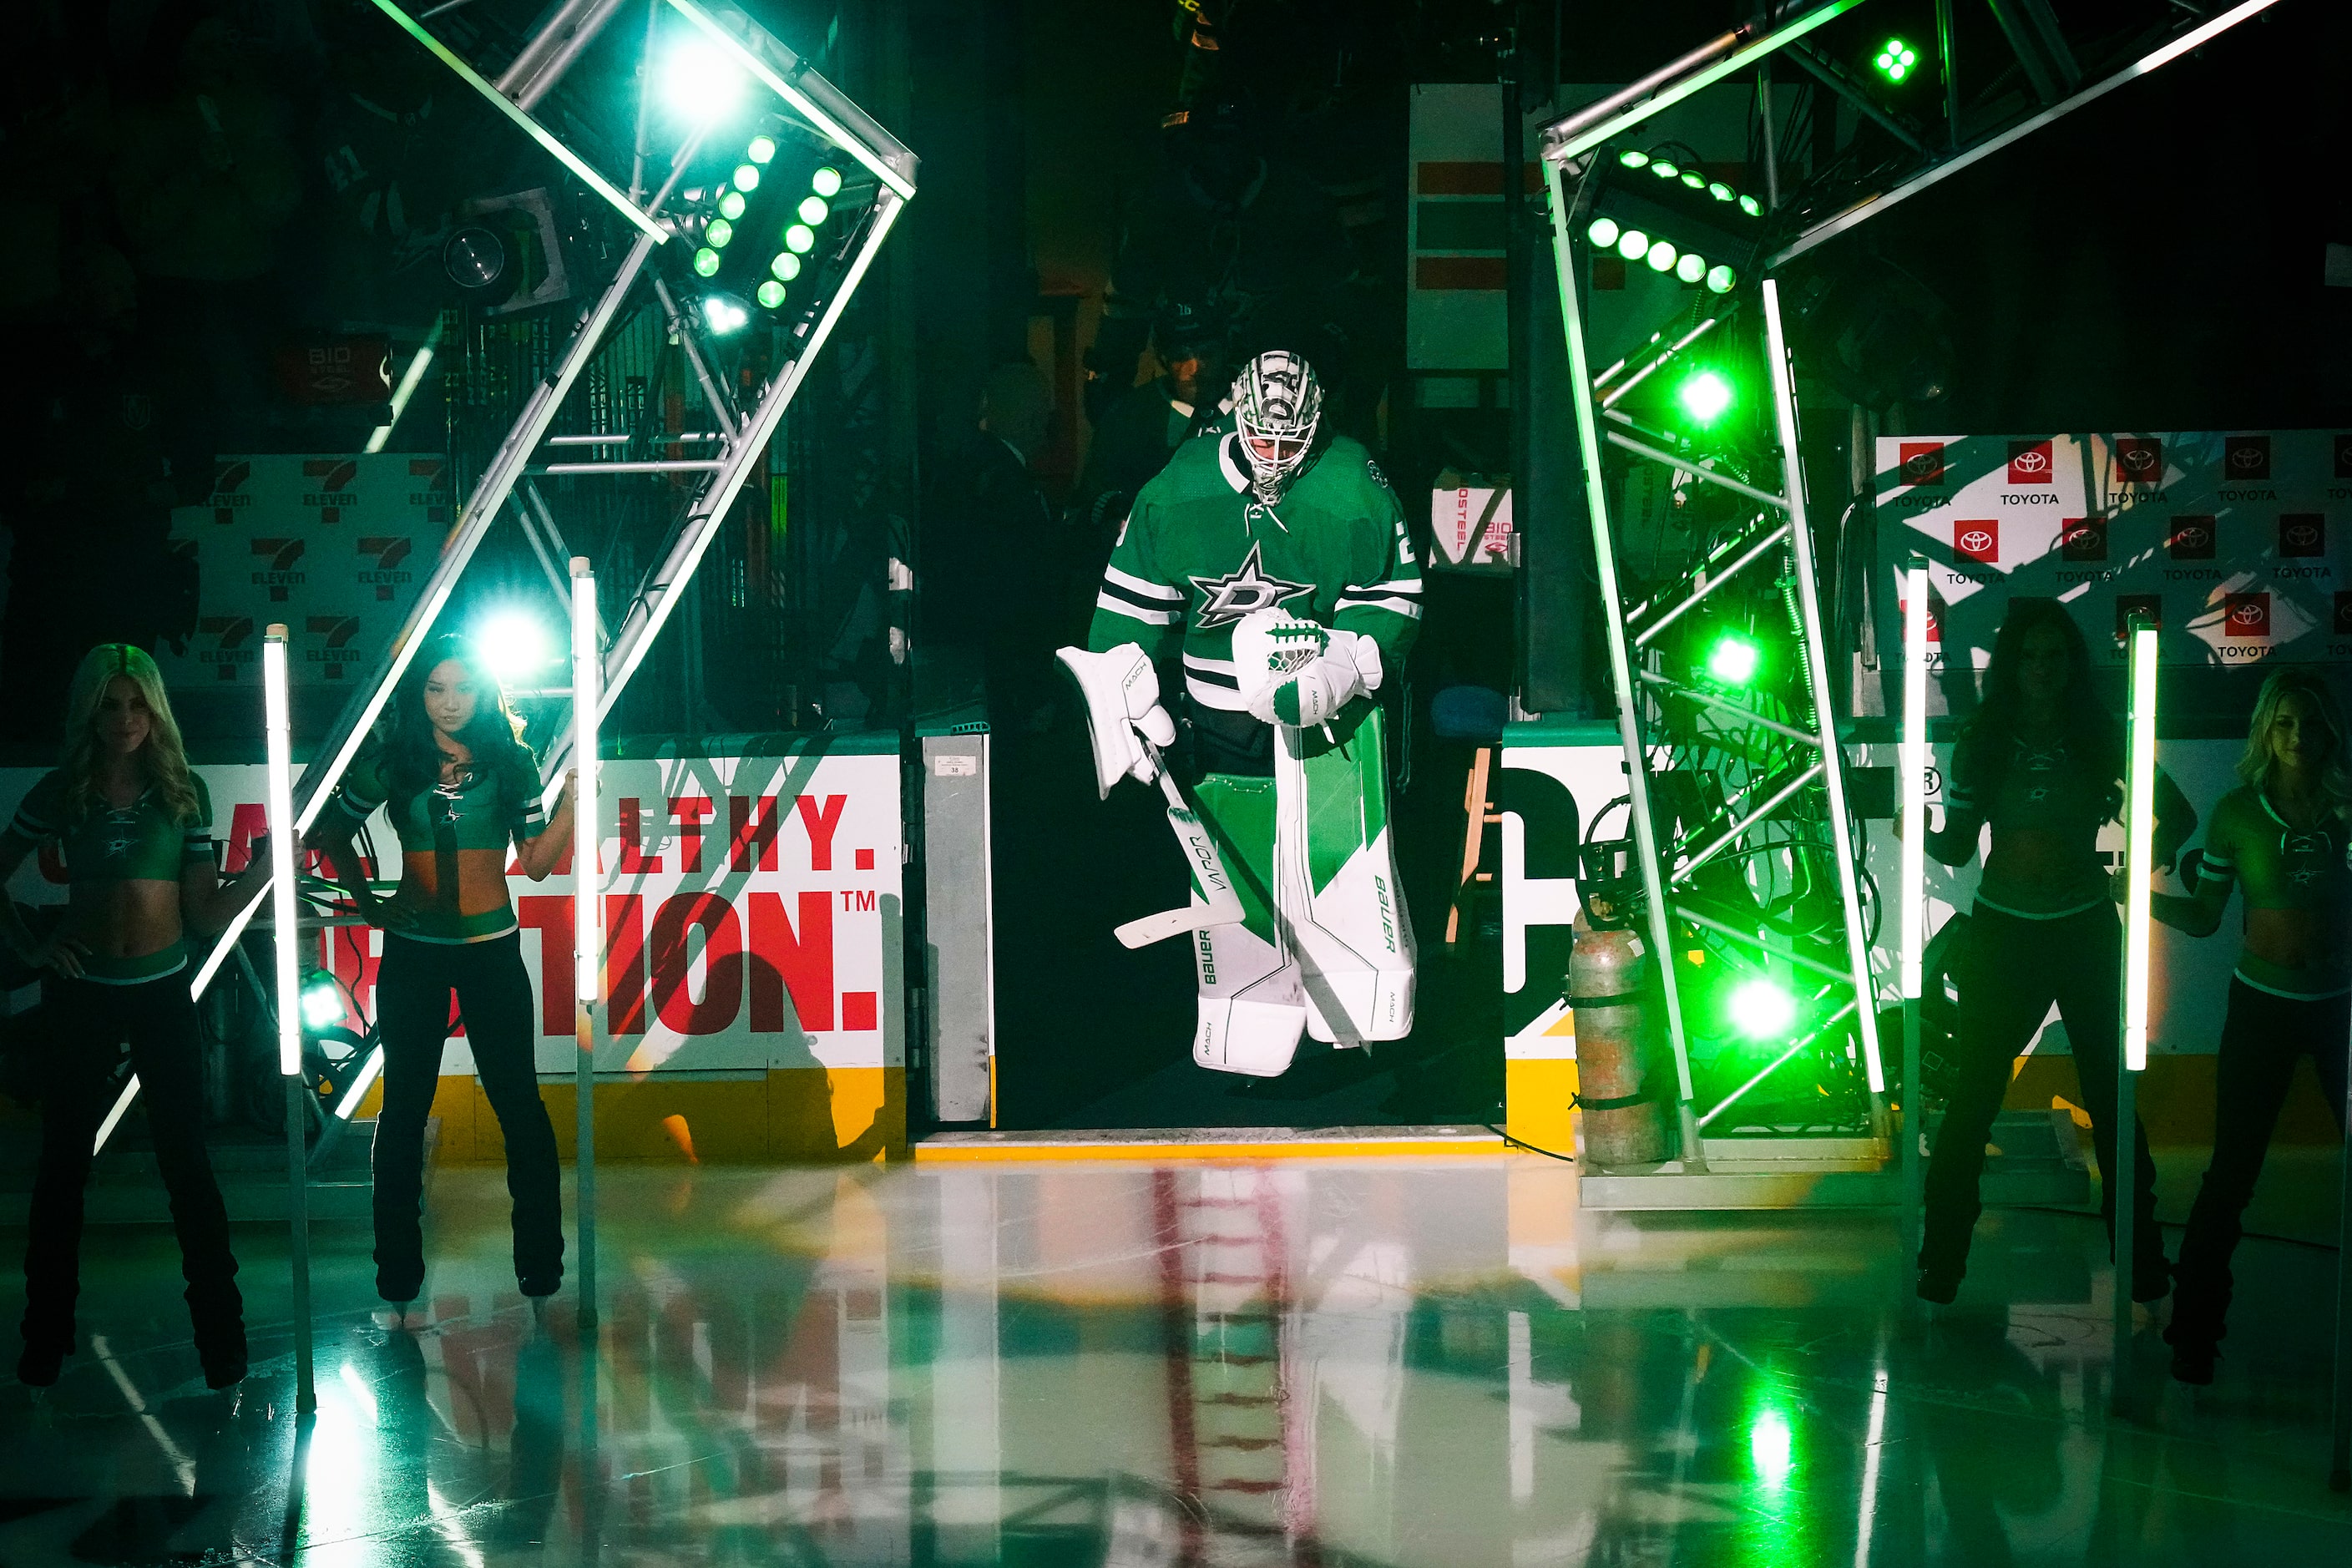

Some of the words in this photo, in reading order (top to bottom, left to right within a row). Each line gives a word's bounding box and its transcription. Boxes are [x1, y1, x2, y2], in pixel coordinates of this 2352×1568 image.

[1893, 496, 1951, 507] TOYOTA
[2000, 493, 2059, 505] TOYOTA
[2109, 492, 2168, 503] TOYOTA
[2218, 489, 2278, 502] TOYOTA
[1947, 573, 2005, 584] TOYOTA
[2055, 571, 2114, 583] TOYOTA
[2163, 569, 2223, 581] TOYOTA
[2272, 567, 2332, 579] TOYOTA
[2218, 646, 2278, 658] TOYOTA
[1125, 661, 1147, 690] MACH
[1189, 835, 1227, 892] VAPOR
[1388, 991, 1396, 1023] MACH
[1204, 1021, 1212, 1055] MACH
